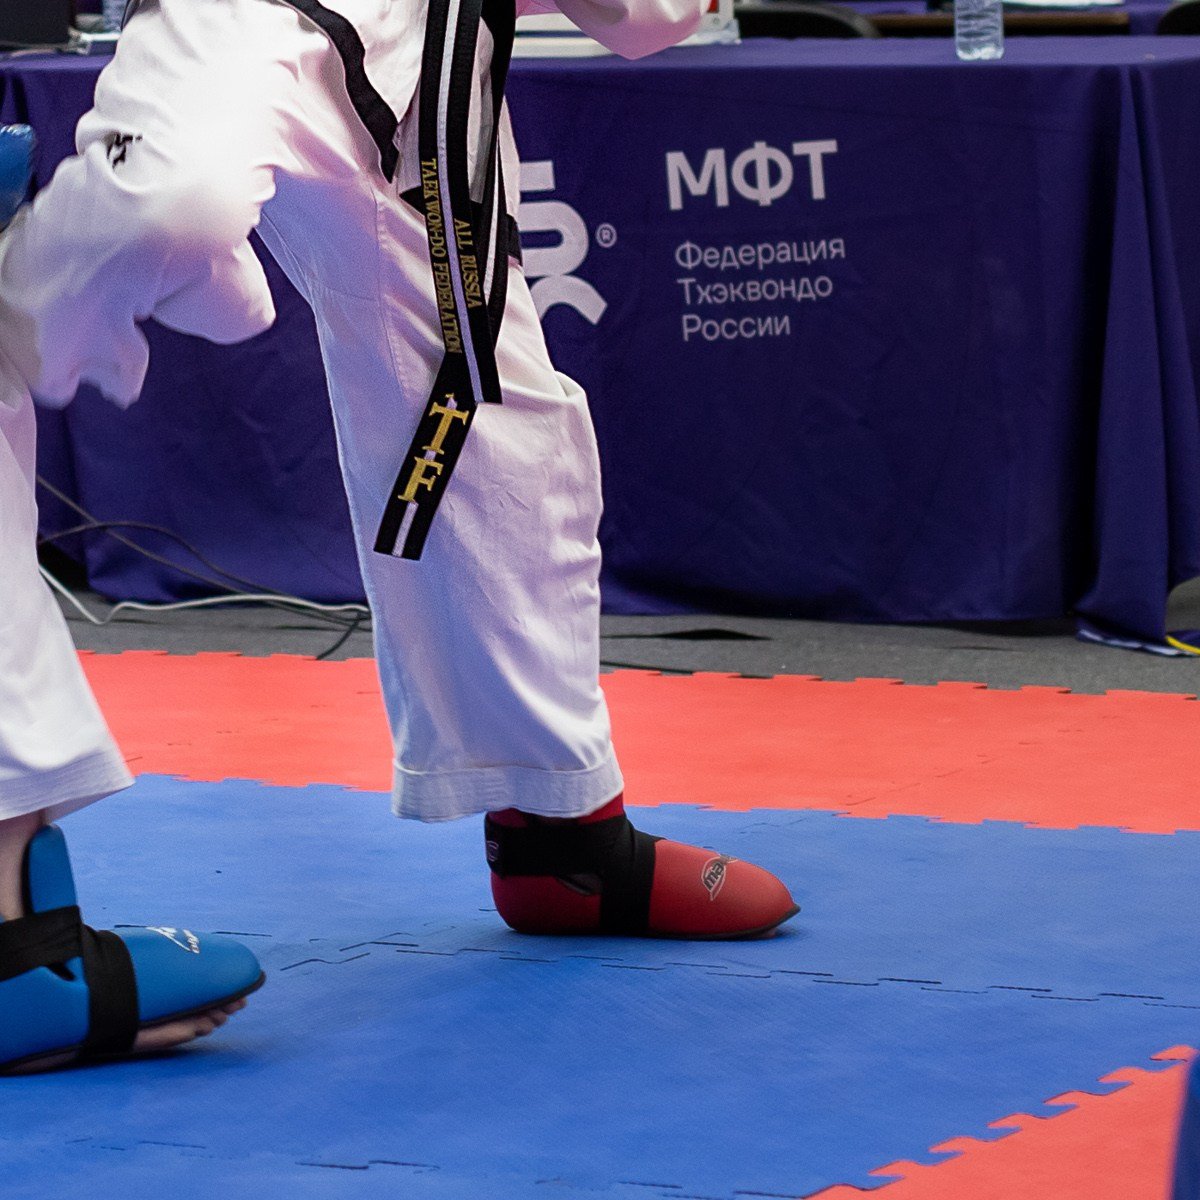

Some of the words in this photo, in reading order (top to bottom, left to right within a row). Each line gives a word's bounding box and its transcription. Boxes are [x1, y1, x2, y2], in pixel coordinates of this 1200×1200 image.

[665, 139, 838, 210] МФТ
[453, 218, 474, 250] ALL
[674, 238, 846, 270] Федерация
[460, 254, 483, 309] RUSSIA
[676, 275, 833, 305] Тхэквондо
[681, 314, 791, 341] России
[397, 393, 470, 503] TF
